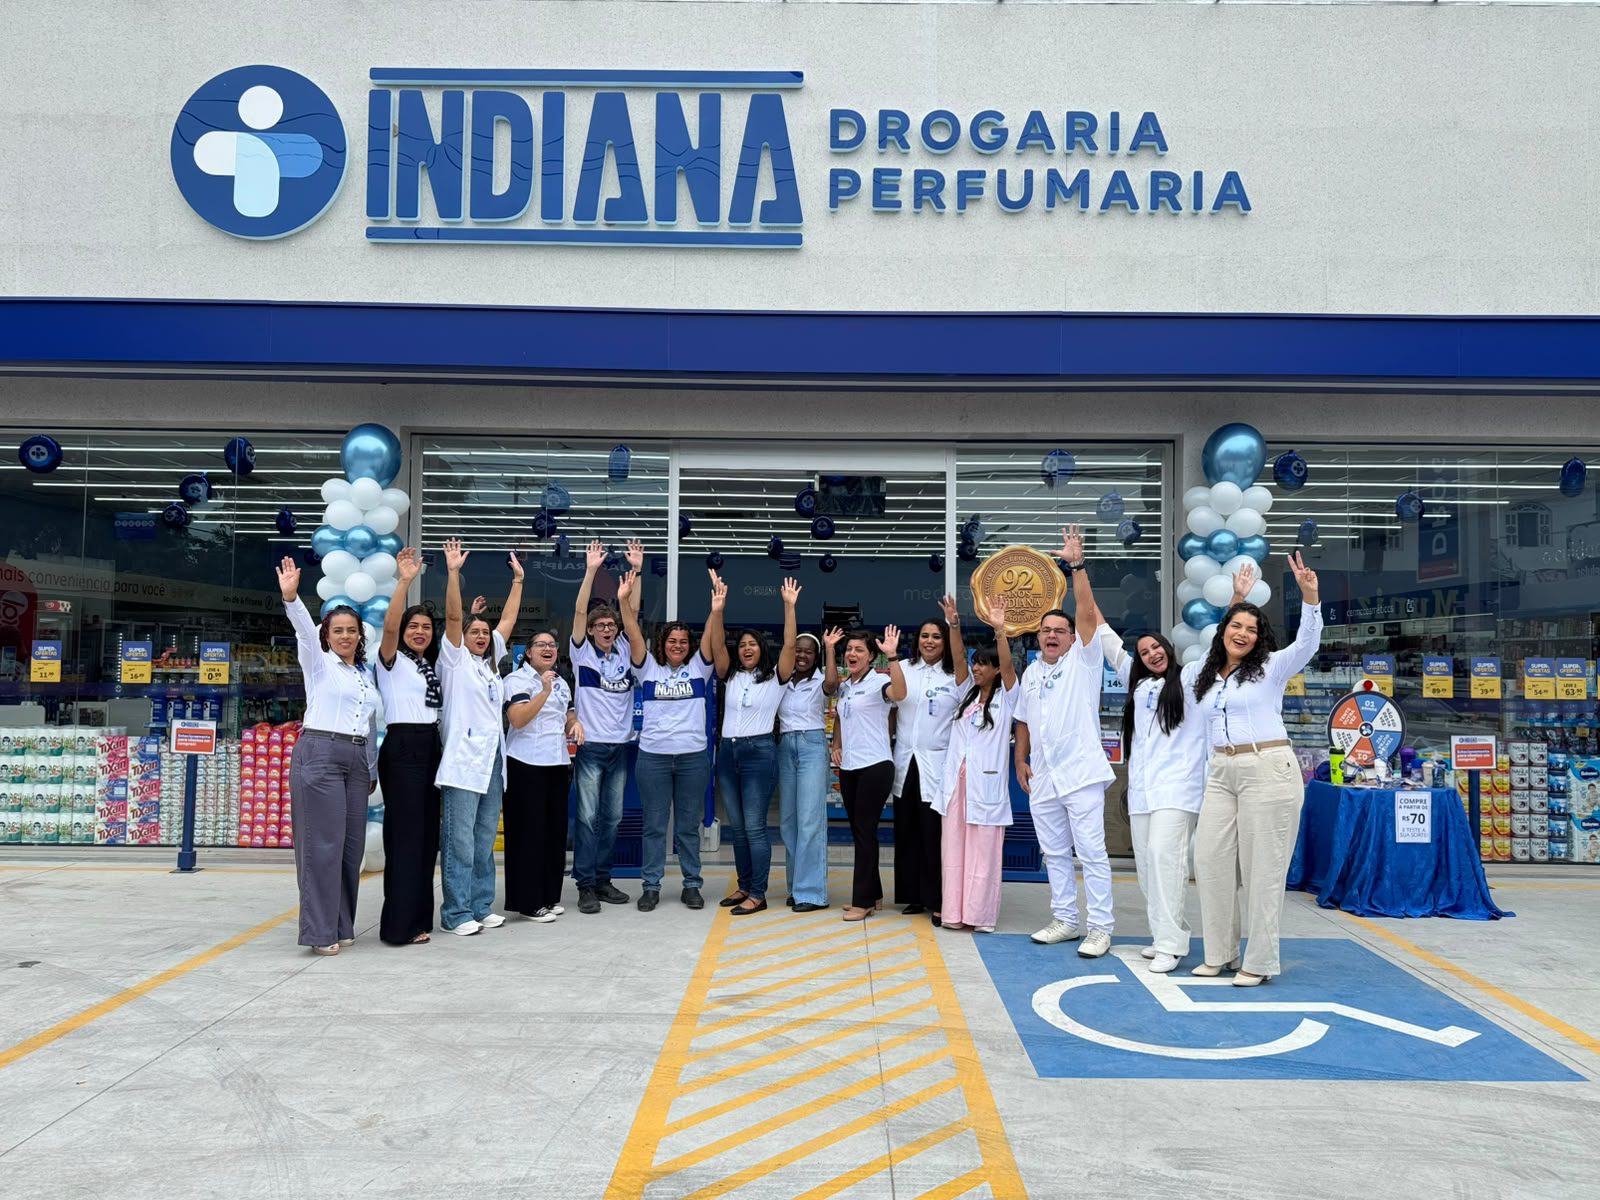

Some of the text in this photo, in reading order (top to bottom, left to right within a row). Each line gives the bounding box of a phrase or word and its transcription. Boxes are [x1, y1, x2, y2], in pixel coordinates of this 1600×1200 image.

[829, 108, 1168, 156] DROGARIA
[367, 88, 804, 228] INDIANA
[829, 167, 1252, 216] PERFUMARIA
[1002, 568, 1034, 593] 92
[654, 681, 694, 698] INDIANA
[1364, 700, 1376, 708] 01
